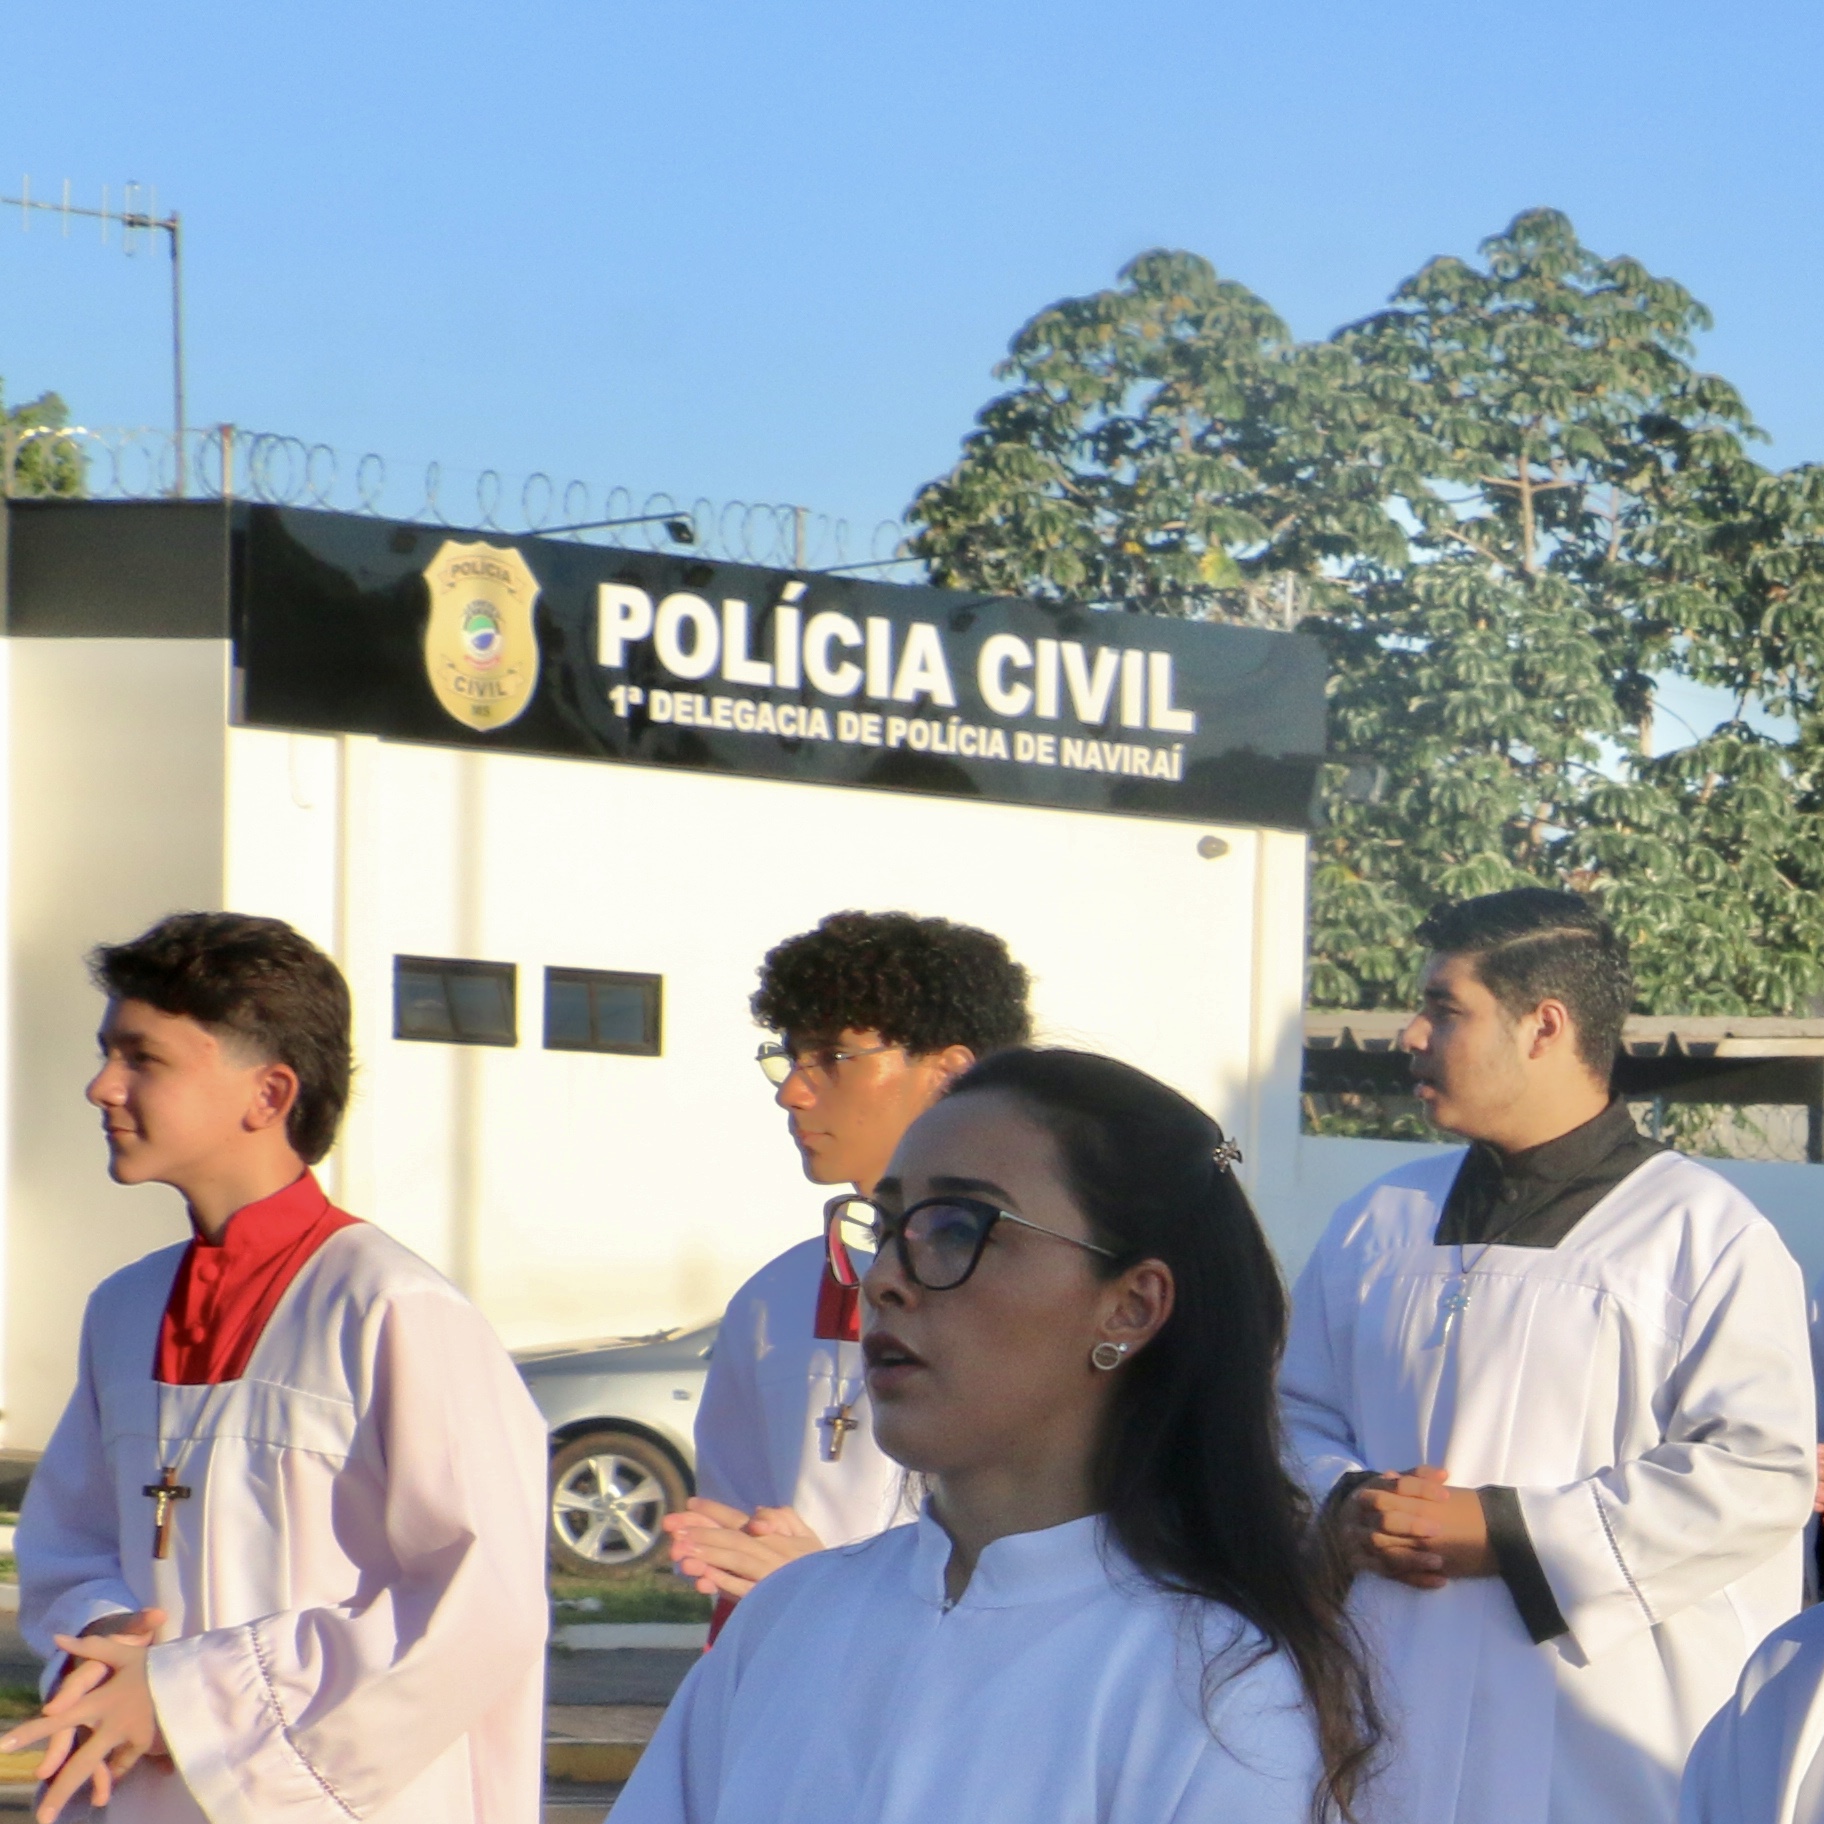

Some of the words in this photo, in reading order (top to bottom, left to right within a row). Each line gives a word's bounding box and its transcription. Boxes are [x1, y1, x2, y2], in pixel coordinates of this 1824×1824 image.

[454, 675, 506, 696] CIVIL
[597, 580, 957, 708] POLÍCIA
[976, 633, 1197, 734] CIVIL
[608, 685, 644, 718] 1ª
[649, 689, 832, 740] DELEGACIA
[837, 710, 884, 746] DE
[885, 715, 1010, 760] POLÍCIA
[1014, 731, 1058, 766] DE
[1060, 736, 1185, 782] NAVIRAÍ
